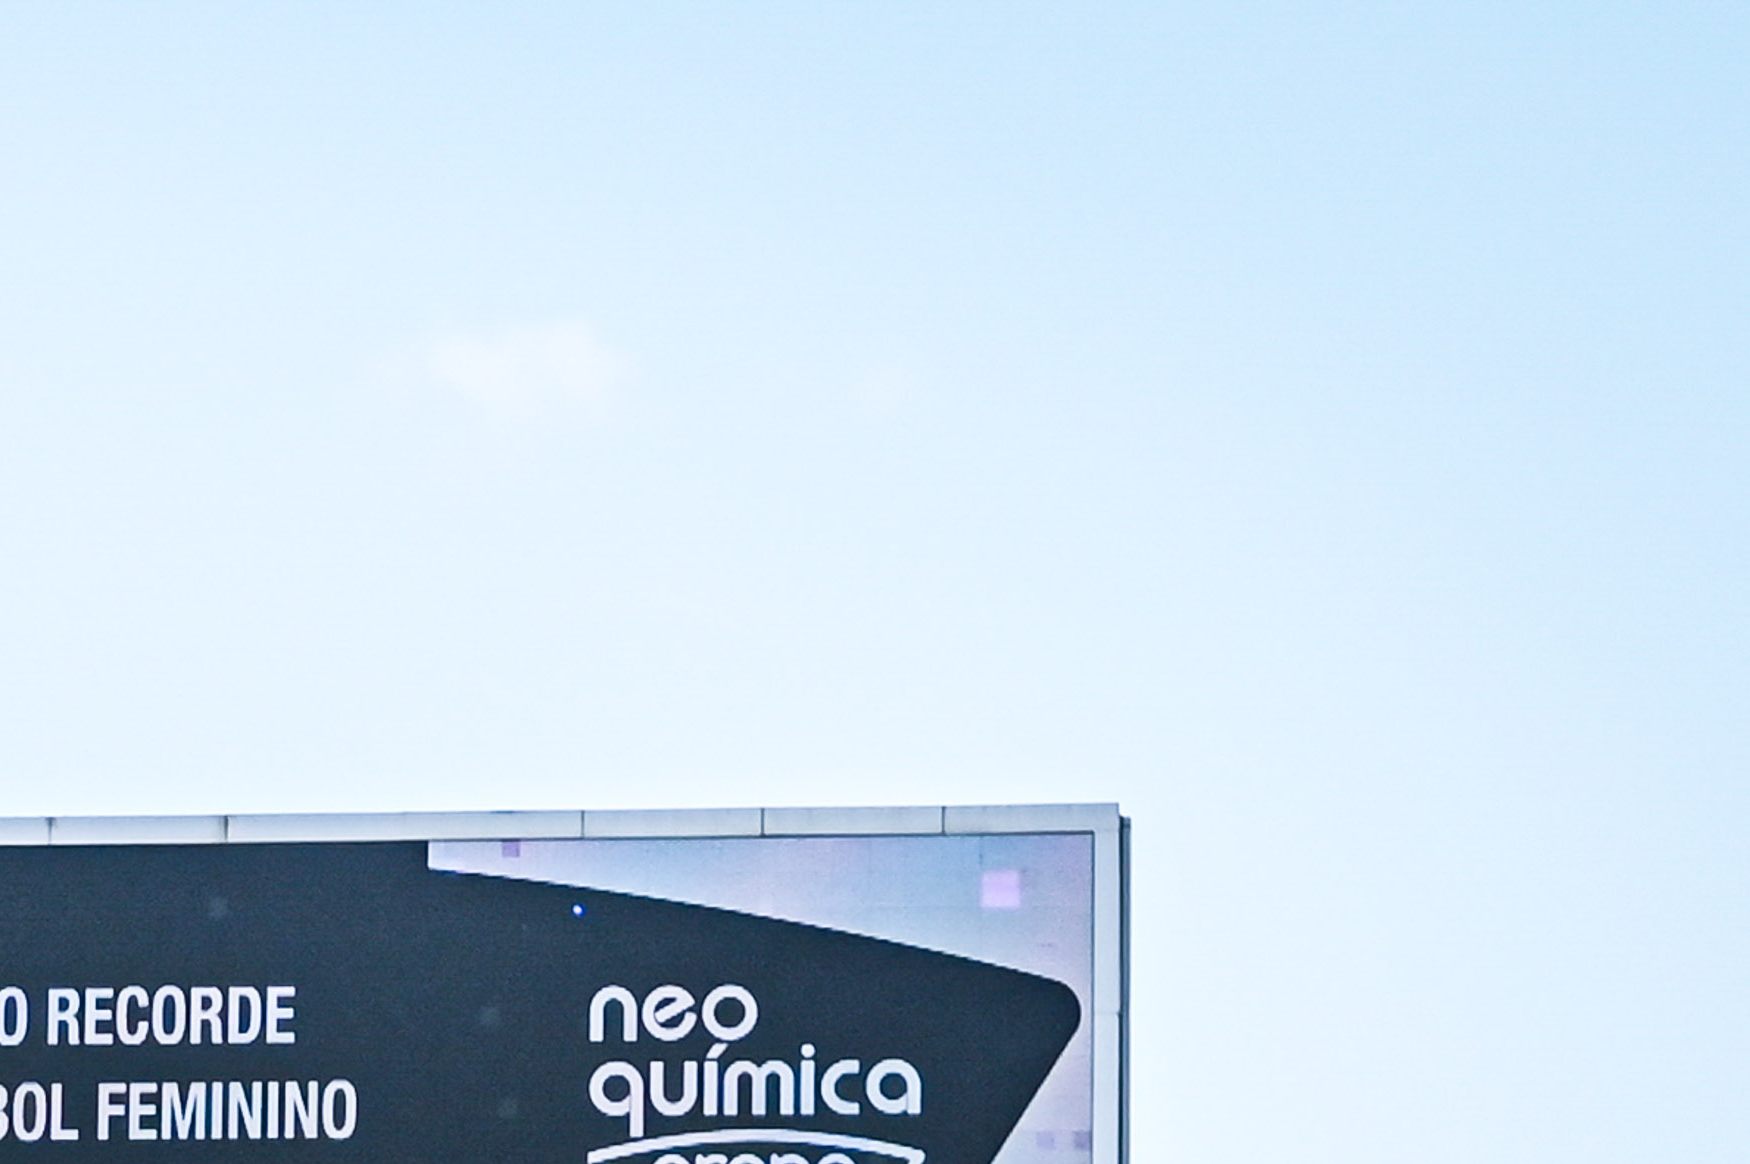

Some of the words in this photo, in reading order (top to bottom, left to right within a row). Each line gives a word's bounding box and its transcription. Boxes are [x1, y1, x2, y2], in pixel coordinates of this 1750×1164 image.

[47, 985, 296, 1047] RECORDE
[588, 984, 759, 1043] neo
[97, 1079, 357, 1142] FEMININO
[588, 1042, 922, 1138] química
